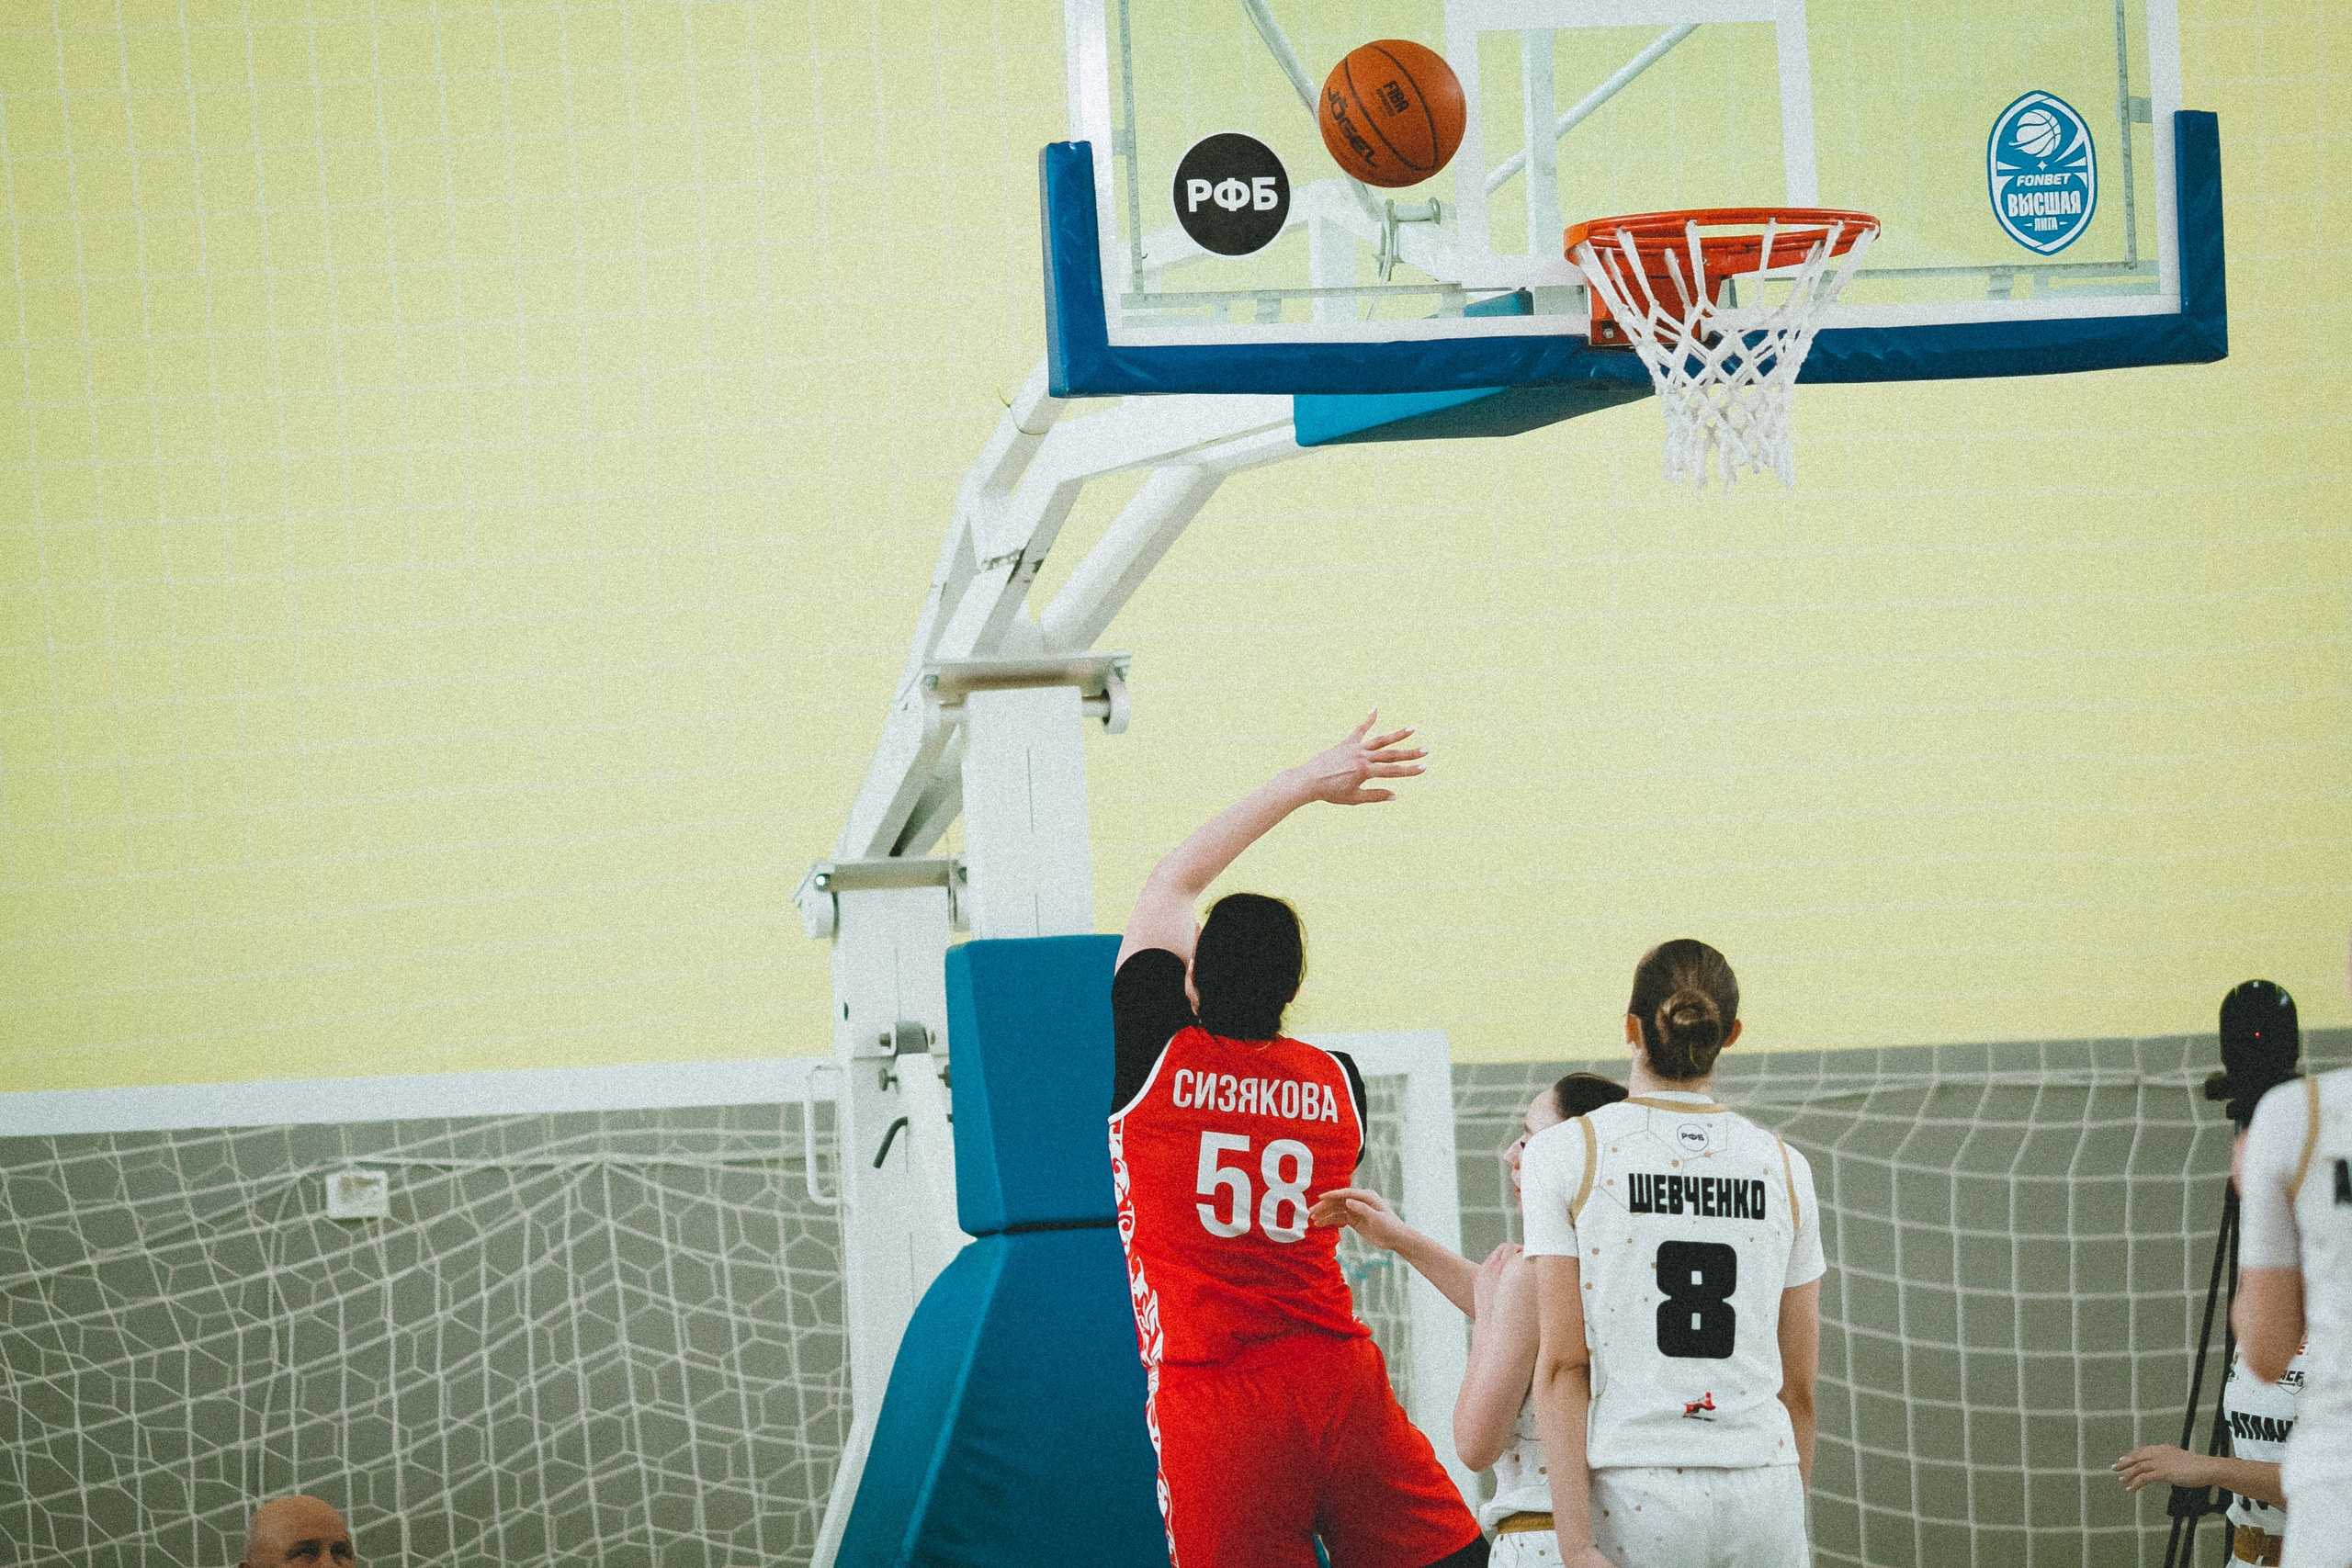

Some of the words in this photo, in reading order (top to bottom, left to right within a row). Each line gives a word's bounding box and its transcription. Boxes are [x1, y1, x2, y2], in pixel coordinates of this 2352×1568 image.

[1383, 80, 1409, 114] FIBA
[1187, 176, 1279, 212] РФБ
[2017, 173, 2071, 187] FONBET
[2007, 190, 2081, 217] ВЫСШАЯ
[2033, 217, 2058, 231] ЛИГА
[1172, 1068, 1339, 1123] СИЗЯКОВА
[1681, 1133, 1705, 1142] РФБ
[1195, 1130, 1314, 1244] 58
[1628, 1172, 1766, 1220] ШЕВЧЕНКО
[1656, 1240, 1737, 1359] 8
